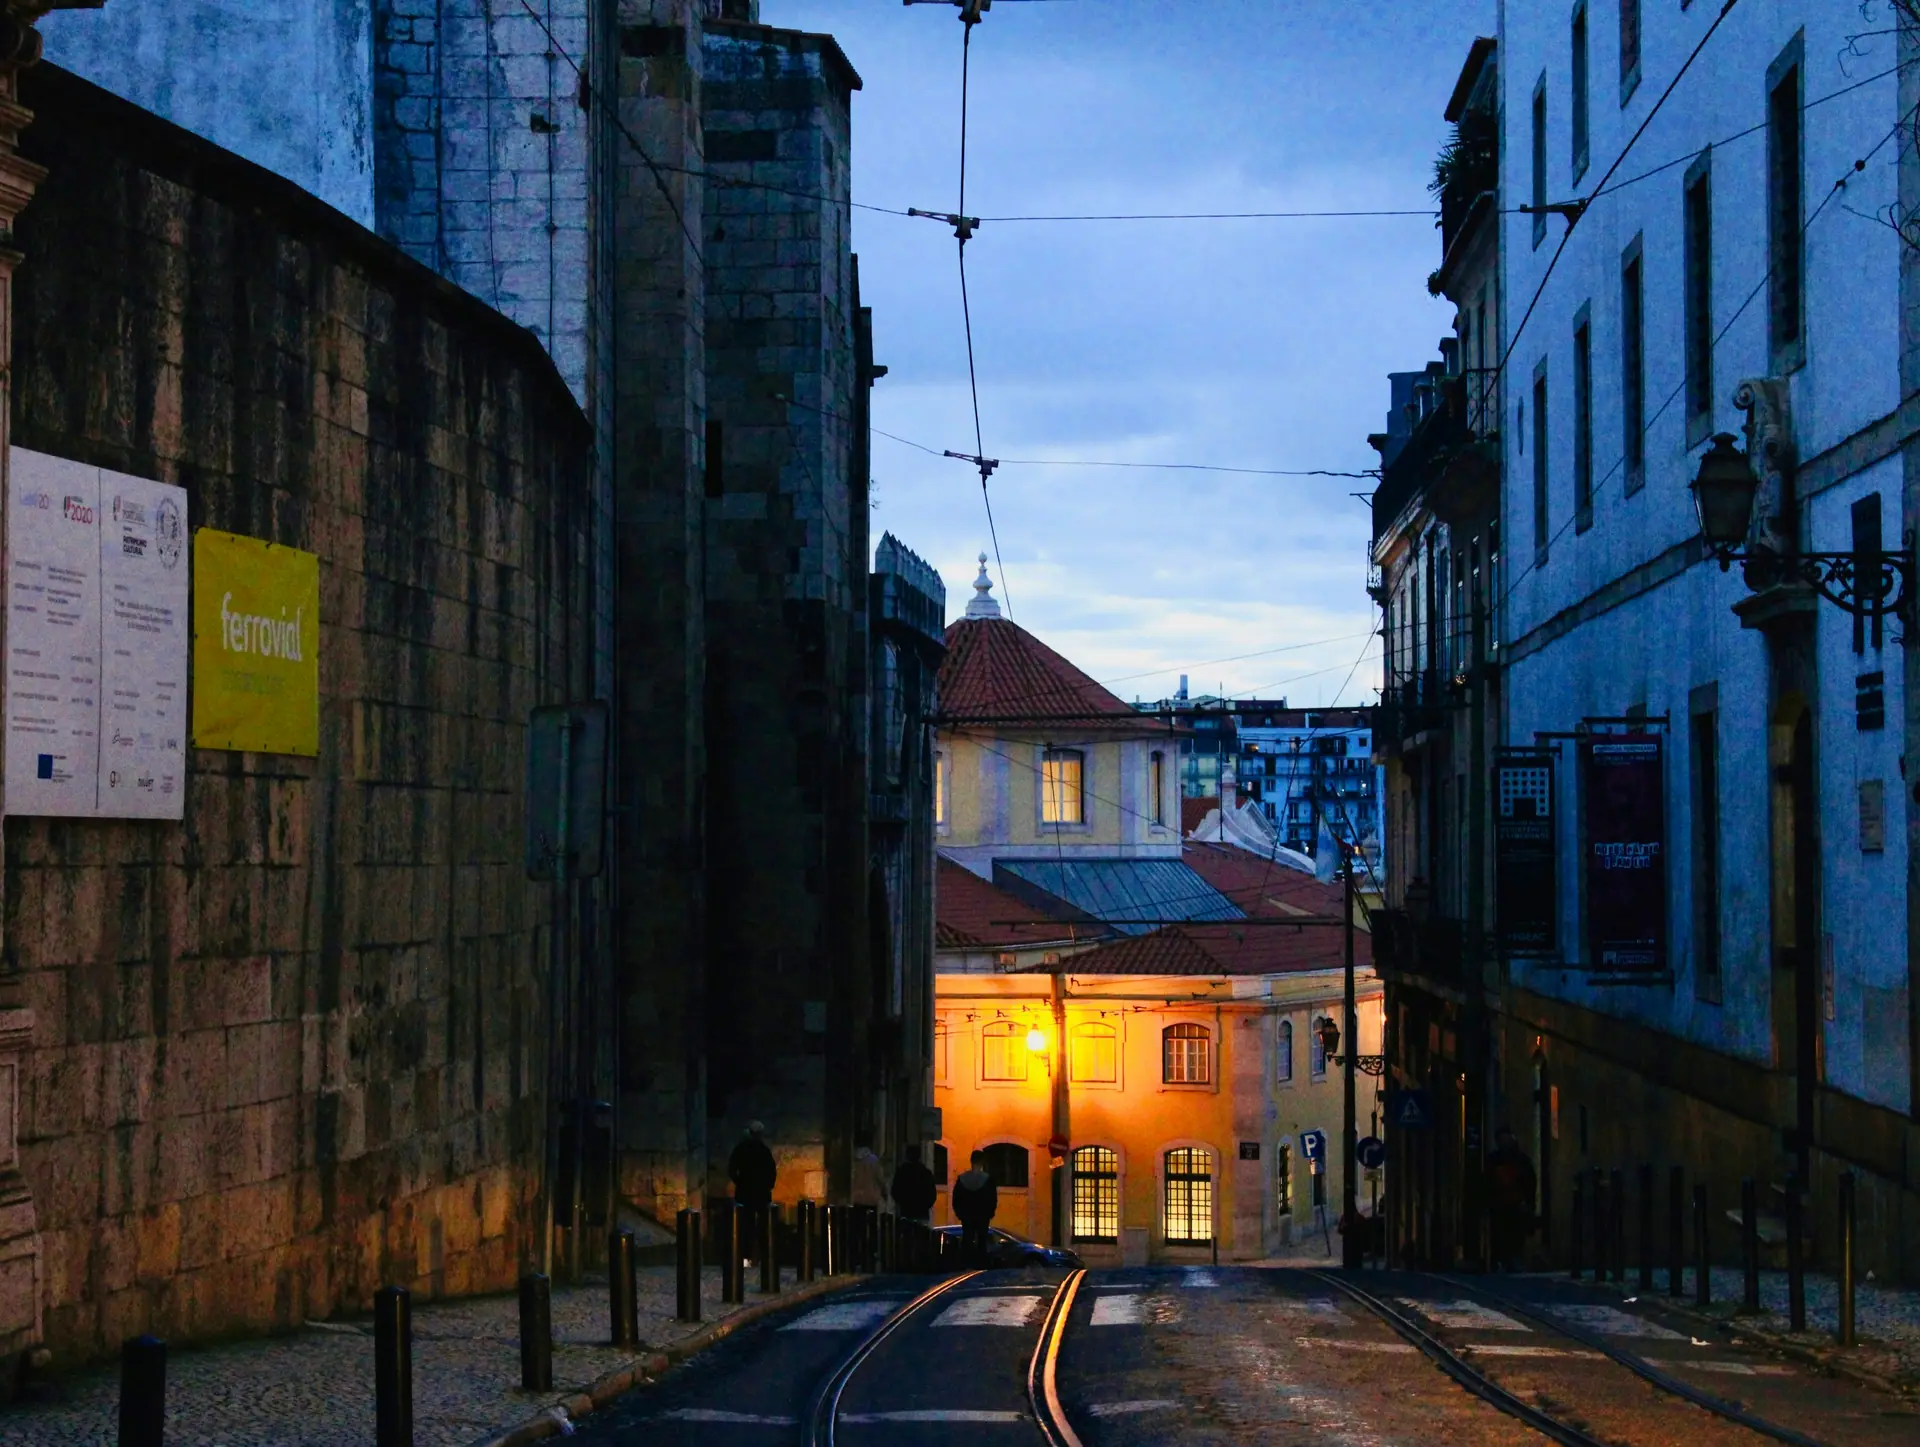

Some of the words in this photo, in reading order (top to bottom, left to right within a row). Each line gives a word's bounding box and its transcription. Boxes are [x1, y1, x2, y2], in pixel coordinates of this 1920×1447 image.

[71, 503, 93, 525] 2020
[221, 591, 303, 662] ferrovial
[1304, 1134, 1317, 1156] P
